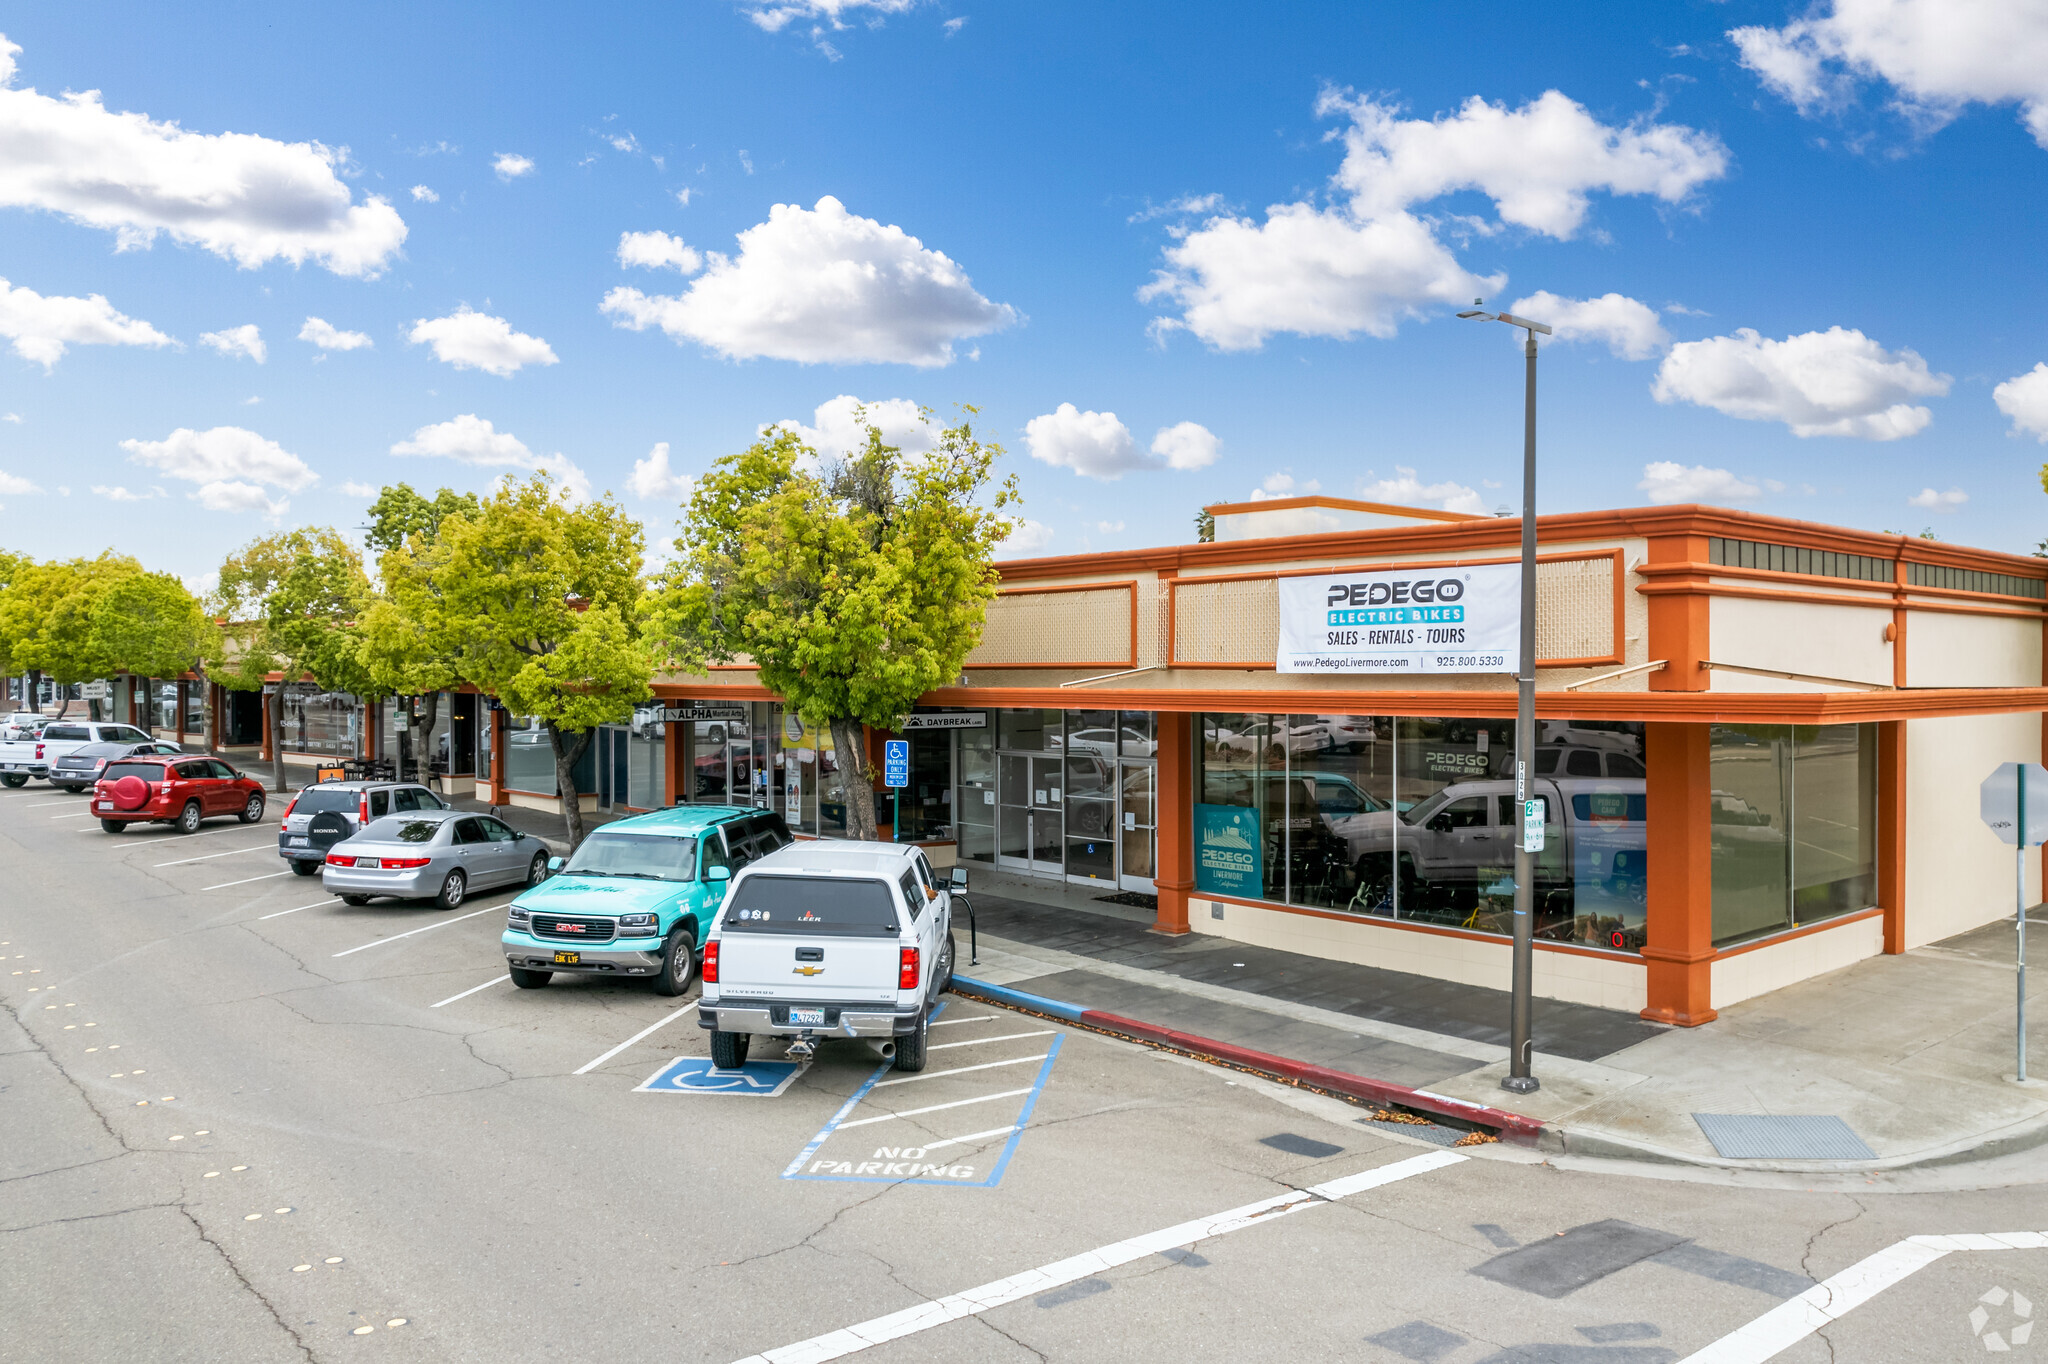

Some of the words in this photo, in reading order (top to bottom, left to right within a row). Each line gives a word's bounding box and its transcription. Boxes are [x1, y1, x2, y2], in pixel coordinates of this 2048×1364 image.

[1327, 578, 1464, 607] PEDEGO
[1330, 610, 1404, 624] ELECTRIC
[1413, 608, 1461, 621] BIKES
[1327, 630, 1358, 646] SALES
[1368, 629, 1414, 645] RENTALS
[1426, 628, 1465, 644] TOURS
[1294, 657, 1409, 669] www.PedegoLivermore.com
[1436, 655, 1504, 667] 925.800.5330
[678, 709, 712, 719] ALPHA
[927, 718, 972, 726] DAYBREAK
[733, 726, 747, 735] 1919
[1425, 751, 1489, 767] PEDEGO
[1430, 764, 1461, 773] ELECTRIC
[1464, 766, 1485, 775] BIKES
[1526, 802, 1533, 815] 2
[1601, 806, 1617, 815] CARE
[1525, 819, 1544, 830] PARKING
[1201, 849, 1254, 864] PEDEGO
[1203, 860, 1233, 869] ELECTRIC
[1234, 863, 1253, 872] BIKES
[1212, 869, 1244, 881] LIVERMORE
[555, 922, 587, 933] GMC
[872, 1146, 927, 1160] NO
[808, 1160, 975, 1178] PARKING
